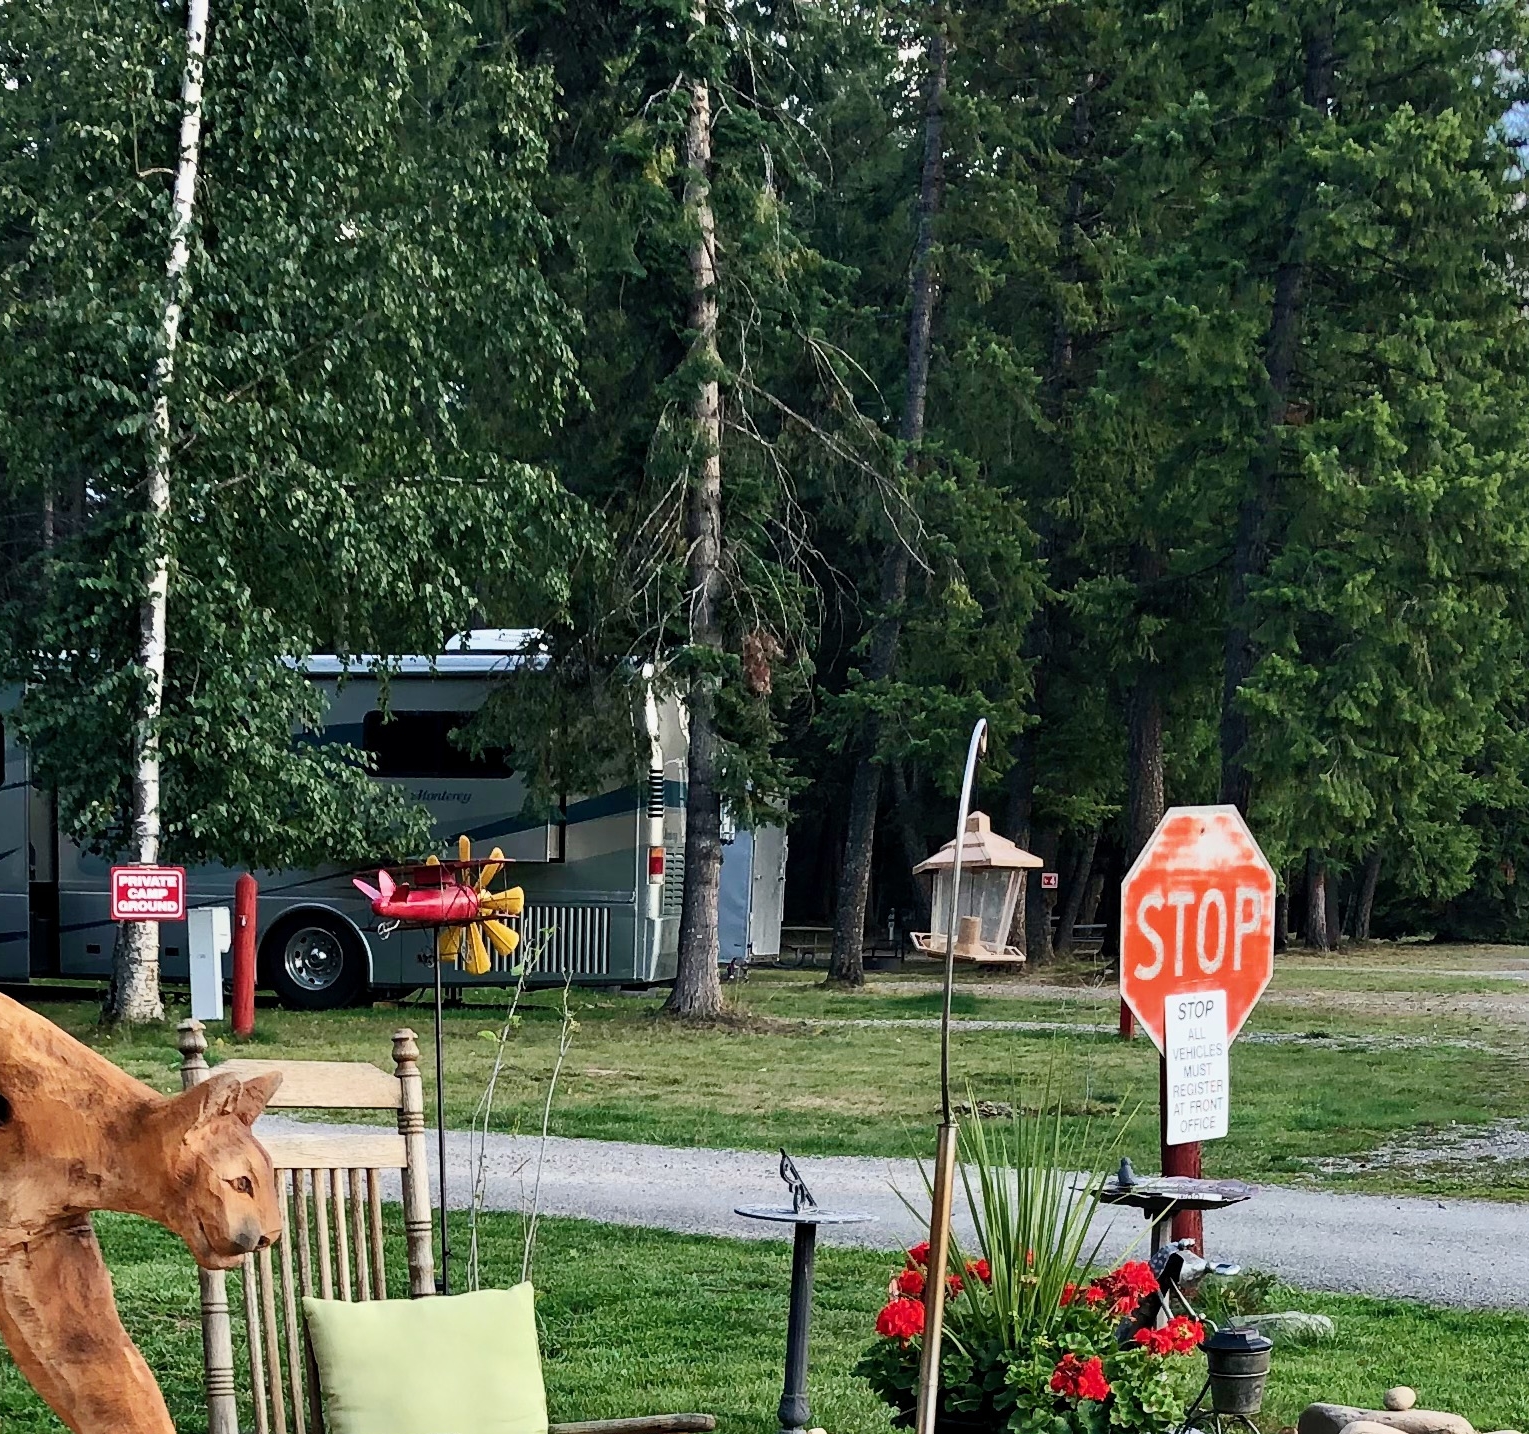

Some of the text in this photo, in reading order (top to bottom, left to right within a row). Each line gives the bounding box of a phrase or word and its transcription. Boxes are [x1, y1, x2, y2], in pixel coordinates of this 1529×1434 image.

[118, 875, 178, 888] PRIVATE
[127, 888, 169, 900] CAMP
[117, 900, 178, 912] GROUND
[1134, 887, 1262, 981] STOP
[1178, 1000, 1214, 1020] STOP
[1188, 1027, 1206, 1041] ALL
[1173, 1043, 1223, 1061] VEHICLES
[1184, 1063, 1212, 1078] MUST
[1173, 1080, 1223, 1098] REGISTER
[1174, 1097, 1224, 1116] AT FRONT
[1180, 1116, 1216, 1133] OFFICE
